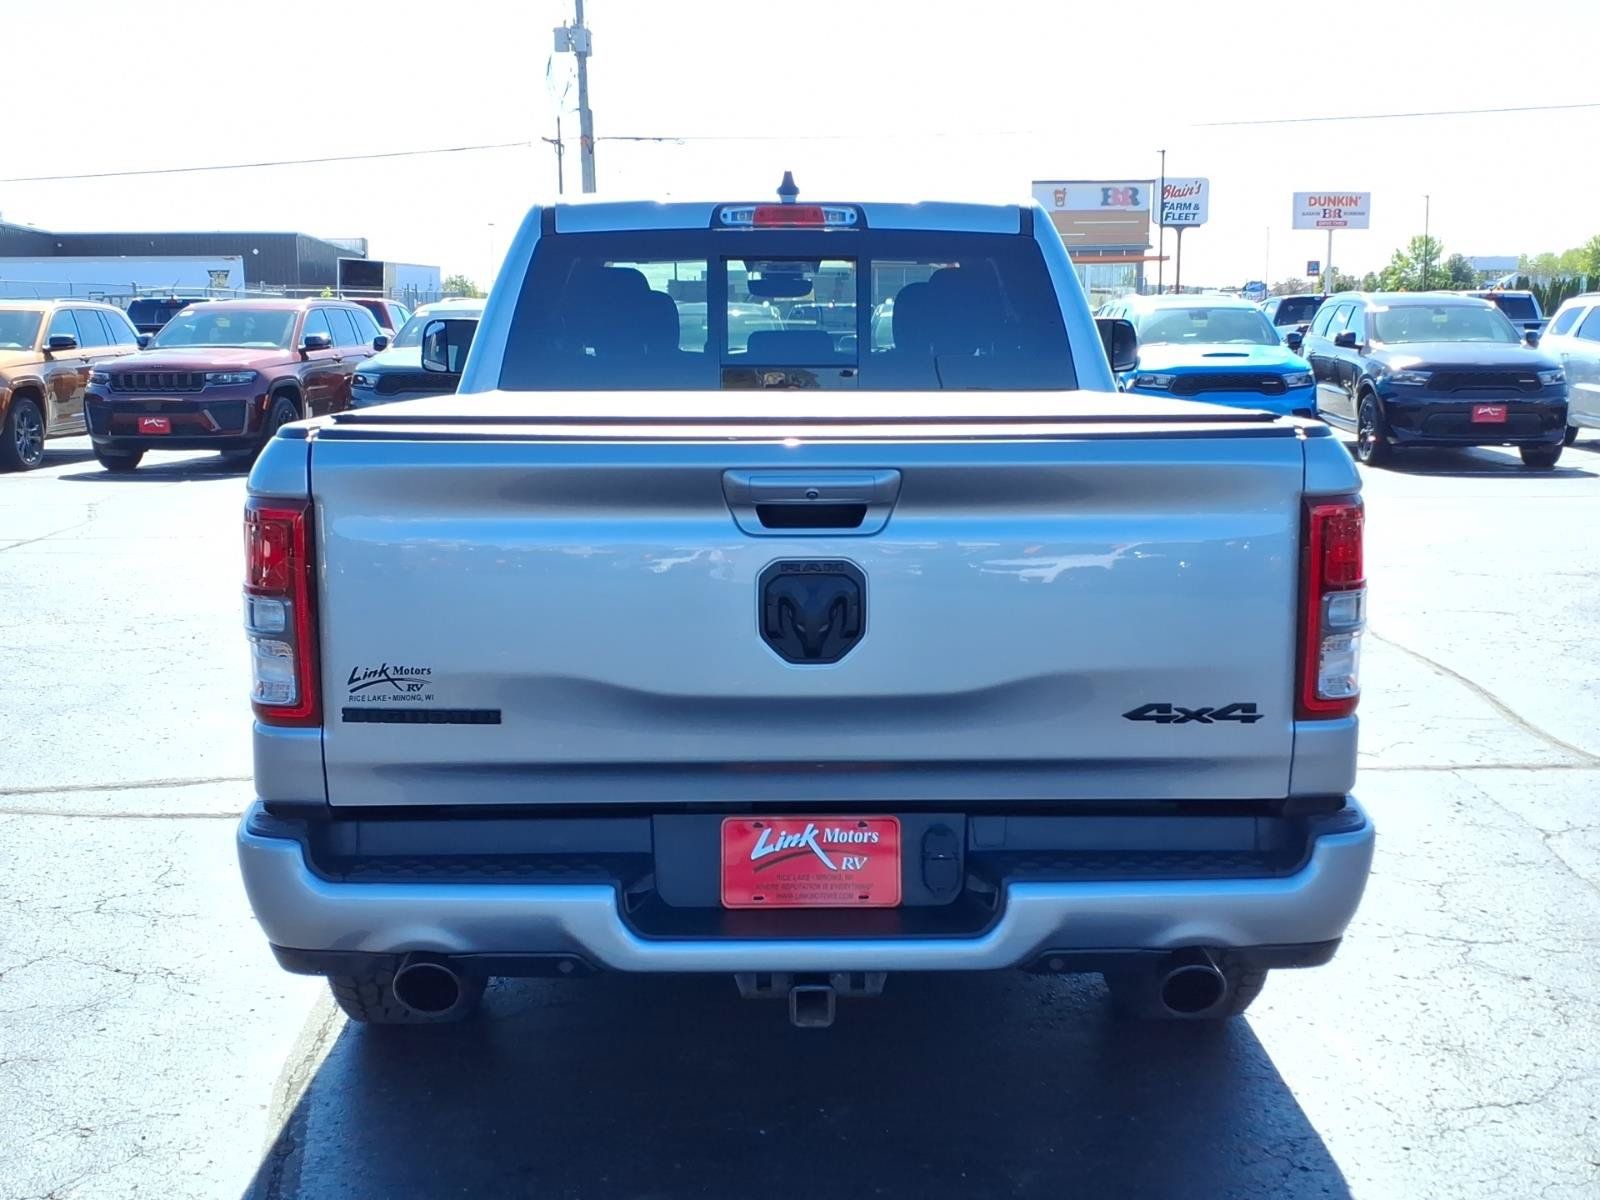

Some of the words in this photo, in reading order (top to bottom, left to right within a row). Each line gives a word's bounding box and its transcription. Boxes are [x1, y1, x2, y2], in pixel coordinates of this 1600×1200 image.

[1162, 181, 1201, 199] Blain's
[1162, 202, 1191, 211] FARM
[1193, 203, 1200, 211] &
[1308, 196, 1362, 207] DUNKIN'
[1164, 212, 1197, 221] FLEET
[347, 663, 404, 692] Link
[393, 666, 432, 676] Motors
[406, 683, 425, 692] RV
[349, 694, 366, 702] RICE
[367, 694, 387, 702] LAKE
[392, 694, 424, 702] MINONG,
[425, 693, 435, 701] WI
[751, 823, 838, 871] Link
[823, 827, 880, 844] Motors
[841, 856, 868, 871] RV
